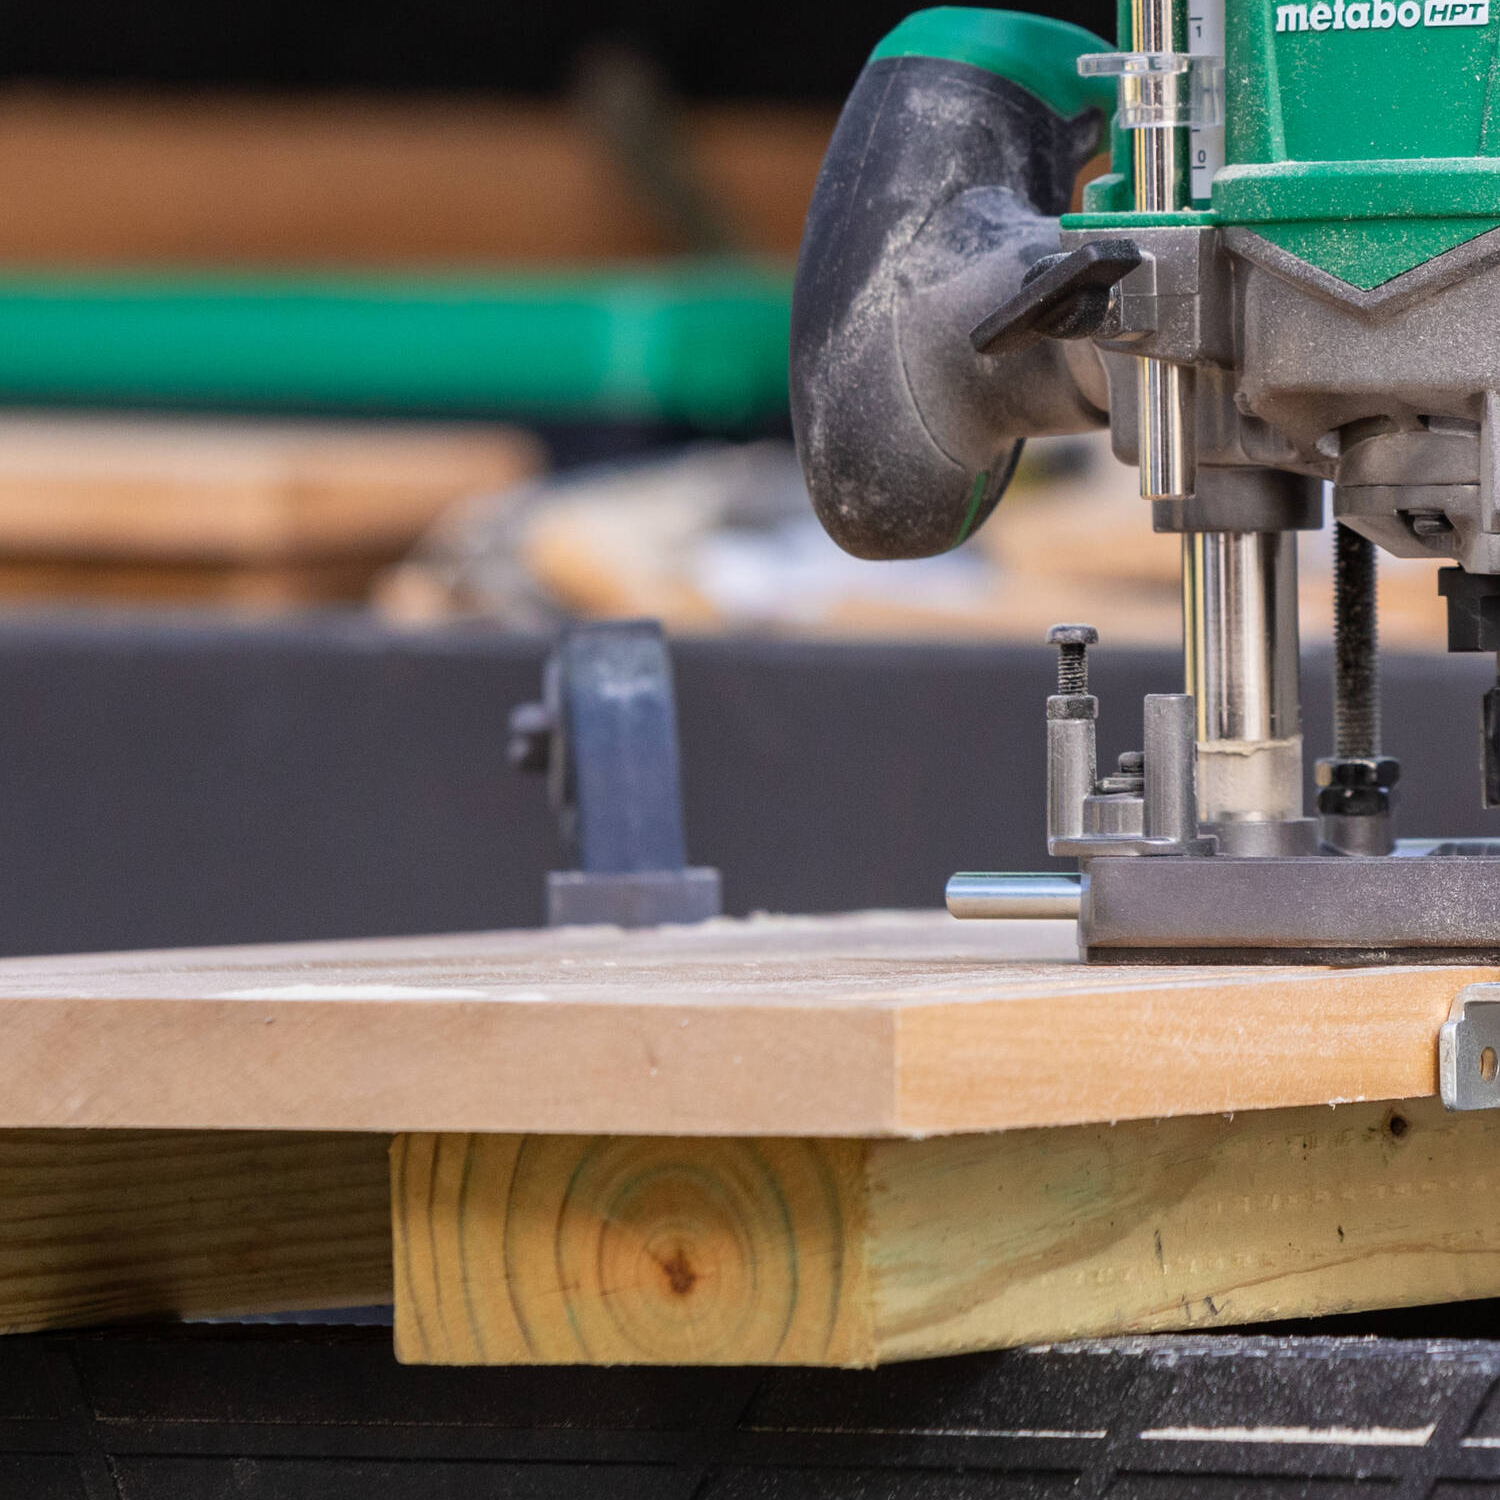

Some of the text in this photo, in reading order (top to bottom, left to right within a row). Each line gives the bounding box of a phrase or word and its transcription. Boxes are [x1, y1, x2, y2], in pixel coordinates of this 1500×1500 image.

[1426, 0, 1487, 24] HPT
[1195, 25, 1202, 38] 1
[1197, 150, 1207, 163] 0
